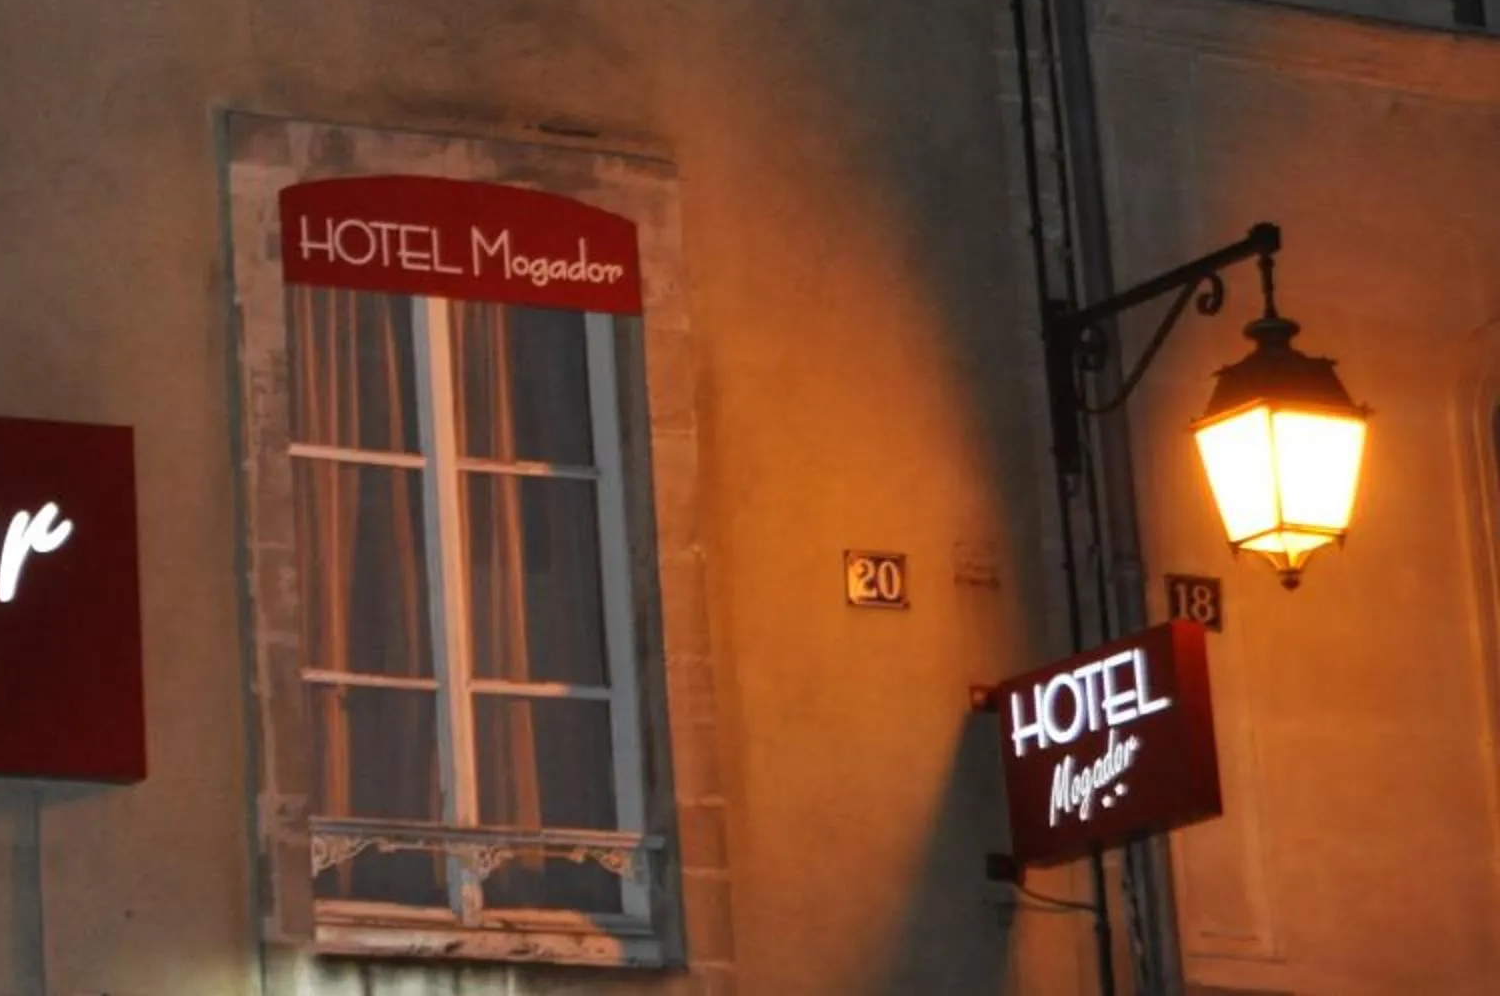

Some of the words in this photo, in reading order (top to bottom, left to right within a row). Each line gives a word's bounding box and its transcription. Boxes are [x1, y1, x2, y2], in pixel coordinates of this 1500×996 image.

[300, 215, 463, 275] HOTEL
[470, 225, 624, 287] Mogador
[852, 558, 901, 601] 20
[1173, 582, 1216, 625] 18
[1011, 647, 1172, 757] HOTEL
[1049, 728, 1141, 828] Mogador
